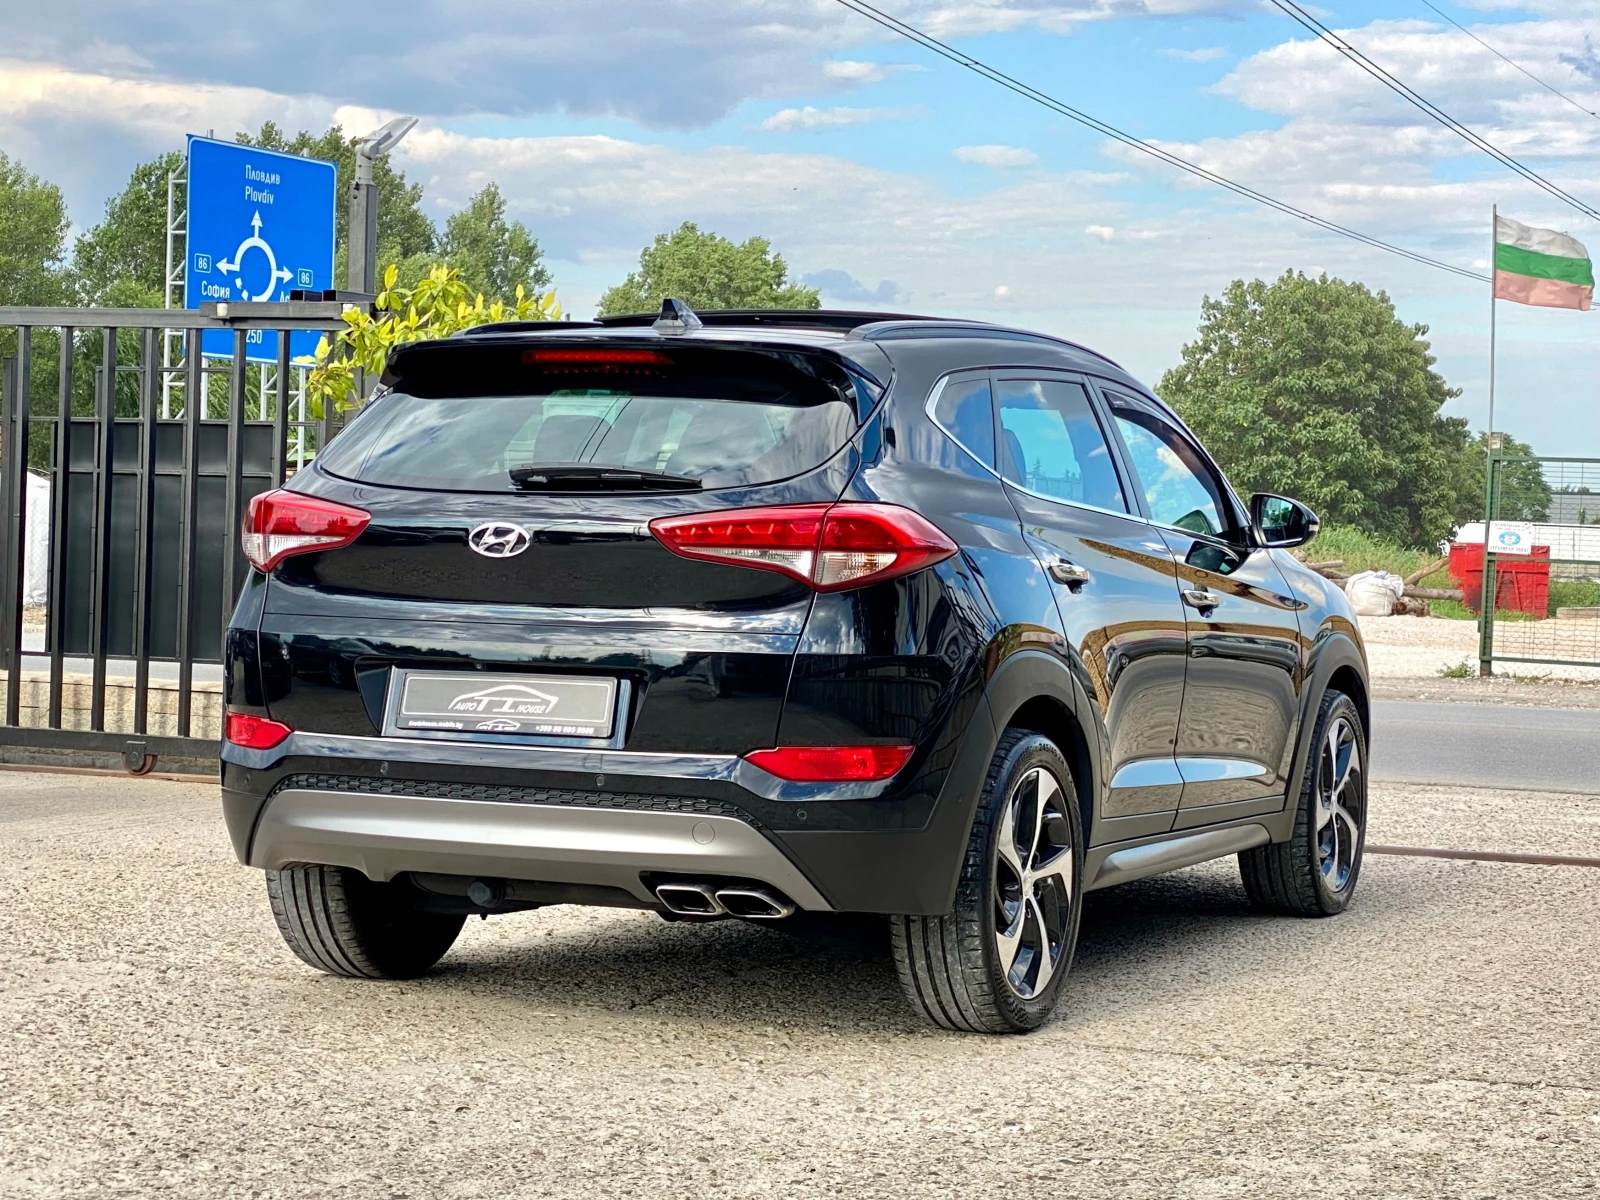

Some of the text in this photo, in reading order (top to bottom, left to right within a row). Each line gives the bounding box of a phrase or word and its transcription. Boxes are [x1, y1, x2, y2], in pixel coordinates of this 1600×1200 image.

[245, 164, 280, 185] Пловдив
[245, 186, 274, 205] Plovdiv
[198, 257, 208, 270] 86
[301, 272, 310, 284] 86
[201, 280, 230, 299] София
[246, 329, 263, 344] 250
[453, 702, 477, 711] AUTO
[516, 704, 546, 714] HOUSE
